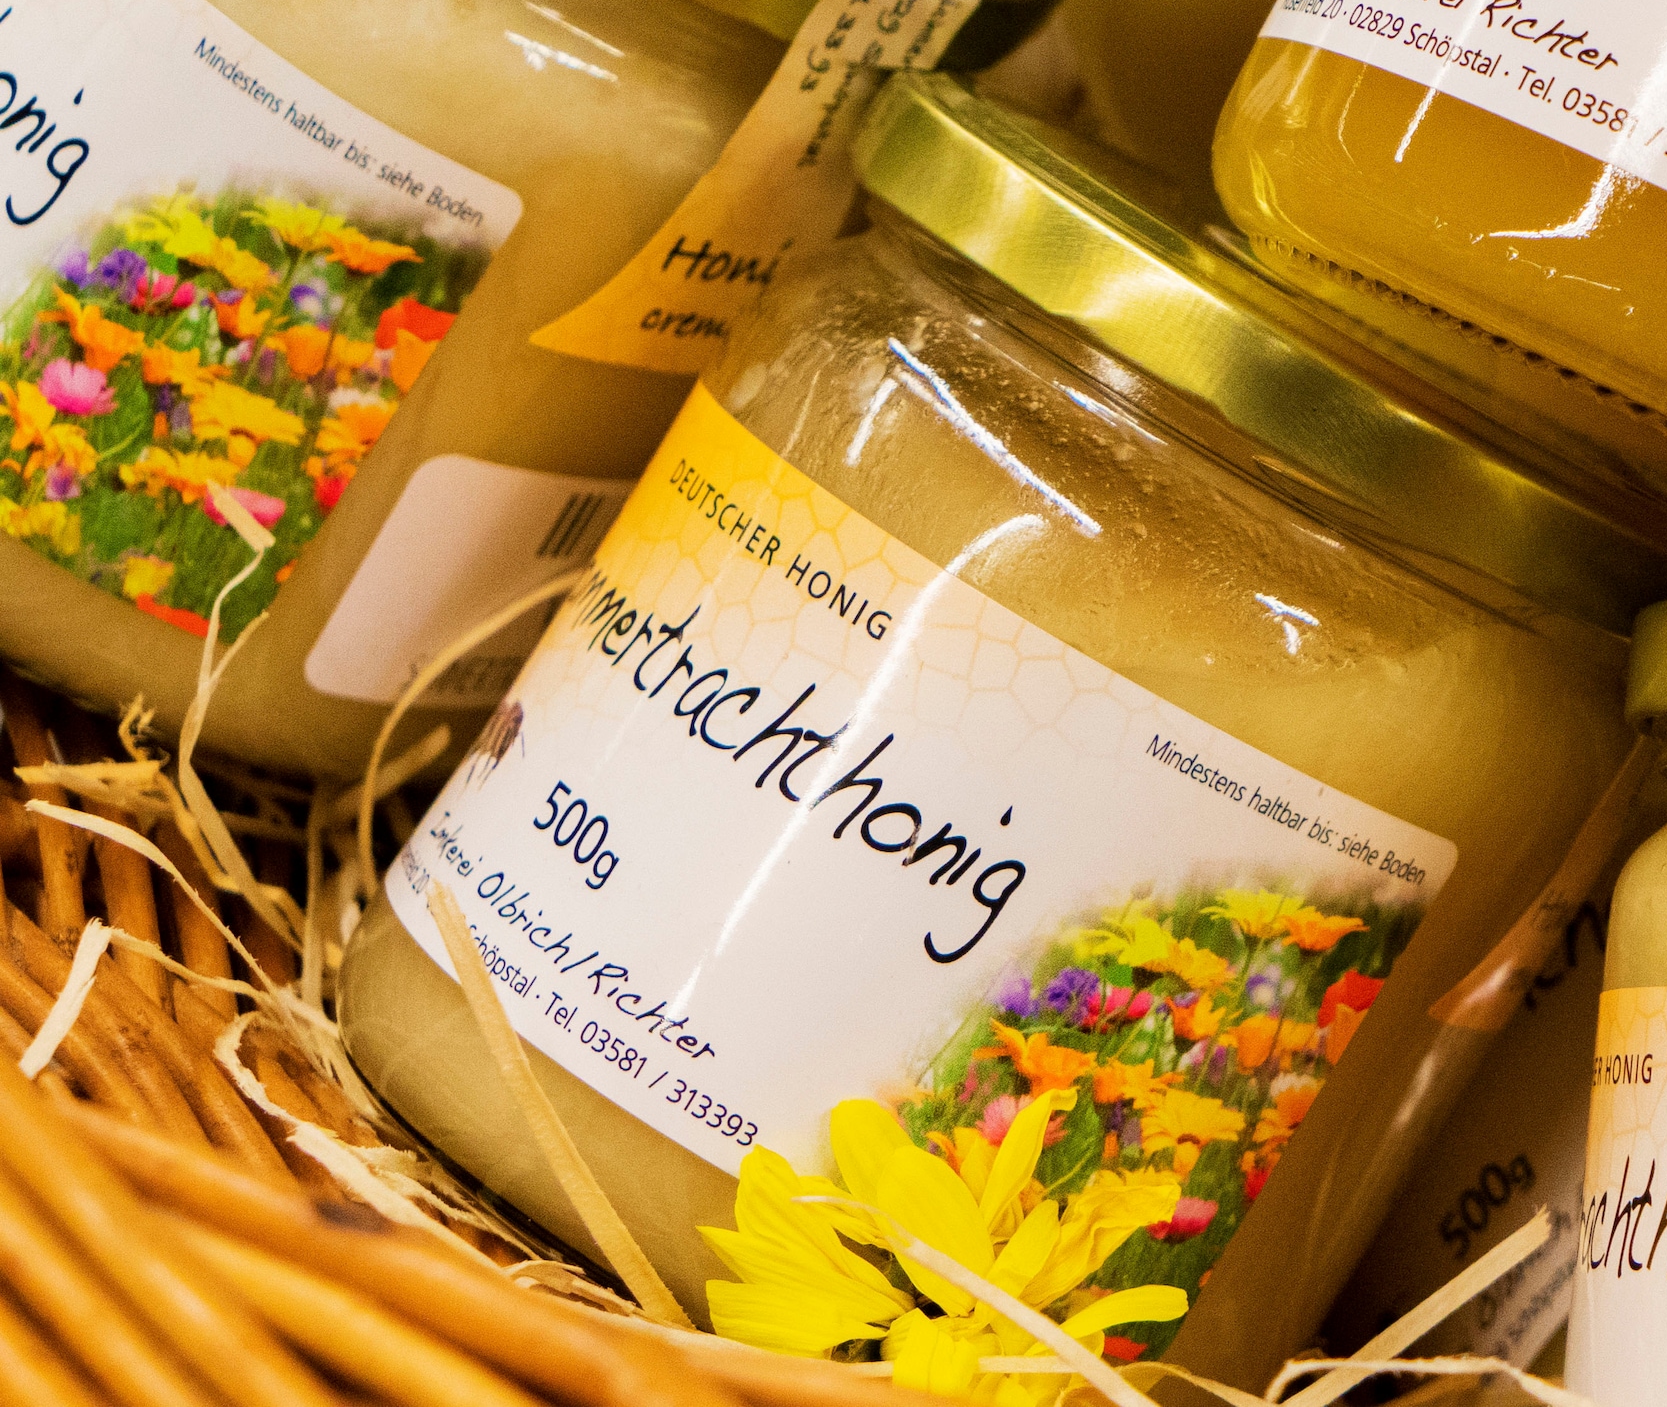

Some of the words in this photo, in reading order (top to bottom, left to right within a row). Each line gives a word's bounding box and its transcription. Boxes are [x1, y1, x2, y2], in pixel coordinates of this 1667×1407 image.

[0, 7, 90, 226] onig
[194, 36, 283, 114] Mindestens
[284, 101, 344, 152] haltbar
[344, 140, 378, 174] bis:
[378, 161, 424, 199] siehe
[426, 185, 484, 228] Boden
[1349, 2, 1404, 40] 02829
[1403, 23, 1500, 79] Schöpstal
[1517, 65, 1555, 102] Tel.
[1562, 87, 1641, 142] 03581
[661, 234, 795, 286] Honi
[669, 457, 780, 565] DEUTSCHER
[786, 556, 894, 642] HONIG
[533, 779, 620, 890] 500g
[1146, 734, 1248, 802] Mindestens
[1248, 786, 1308, 832] haltbar
[1308, 816, 1339, 847] bis:
[1337, 833, 1380, 867] siehe
[1379, 850, 1426, 886] Boden
[545, 992, 572, 1033] Tel.
[580, 1020, 647, 1079] 03581
[665, 1079, 759, 1146] 313393
[1605, 1054, 1653, 1084] HONIG
[1438, 1151, 1537, 1260] 500g
